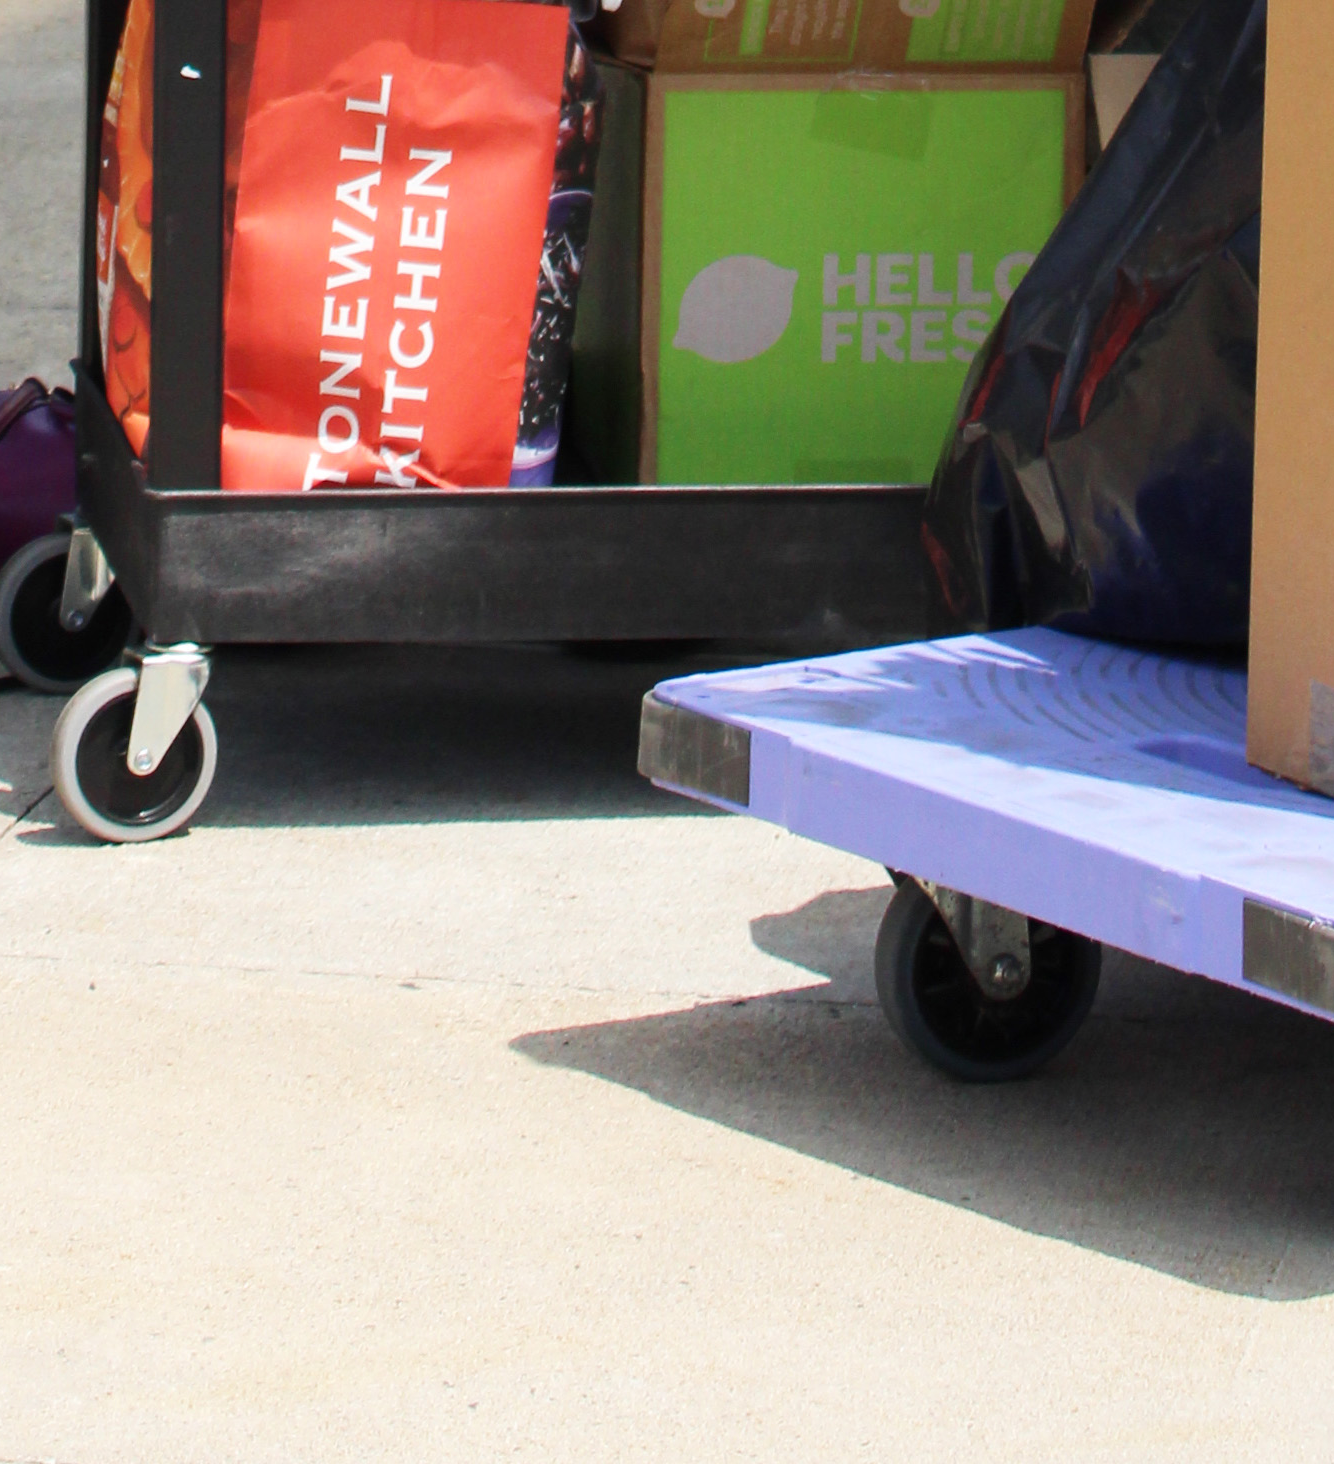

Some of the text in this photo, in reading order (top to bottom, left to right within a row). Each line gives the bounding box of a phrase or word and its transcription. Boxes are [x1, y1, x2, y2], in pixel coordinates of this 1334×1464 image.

[303, 74, 393, 491] TONEWALL
[374, 148, 453, 489] KITCHEN
[821, 309, 992, 363] FRES
